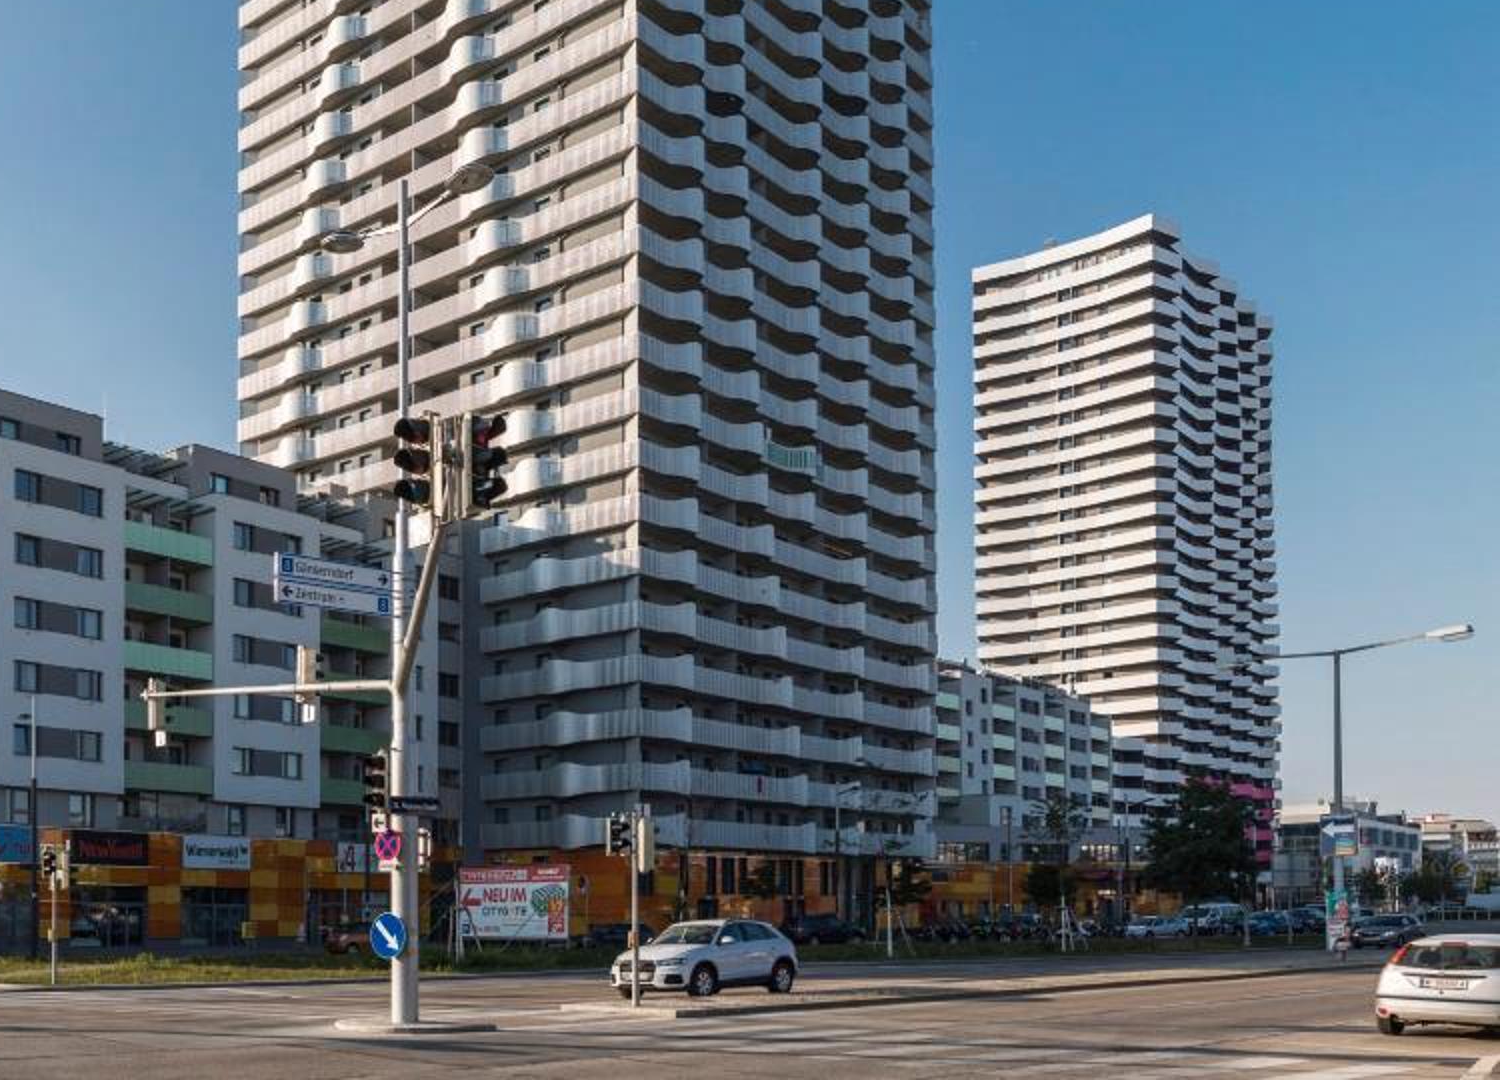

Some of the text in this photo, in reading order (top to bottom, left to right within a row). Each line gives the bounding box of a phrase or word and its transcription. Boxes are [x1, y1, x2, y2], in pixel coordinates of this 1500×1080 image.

[483, 888, 527, 903] NEU IM
[482, 905, 528, 917] CITYGTE
